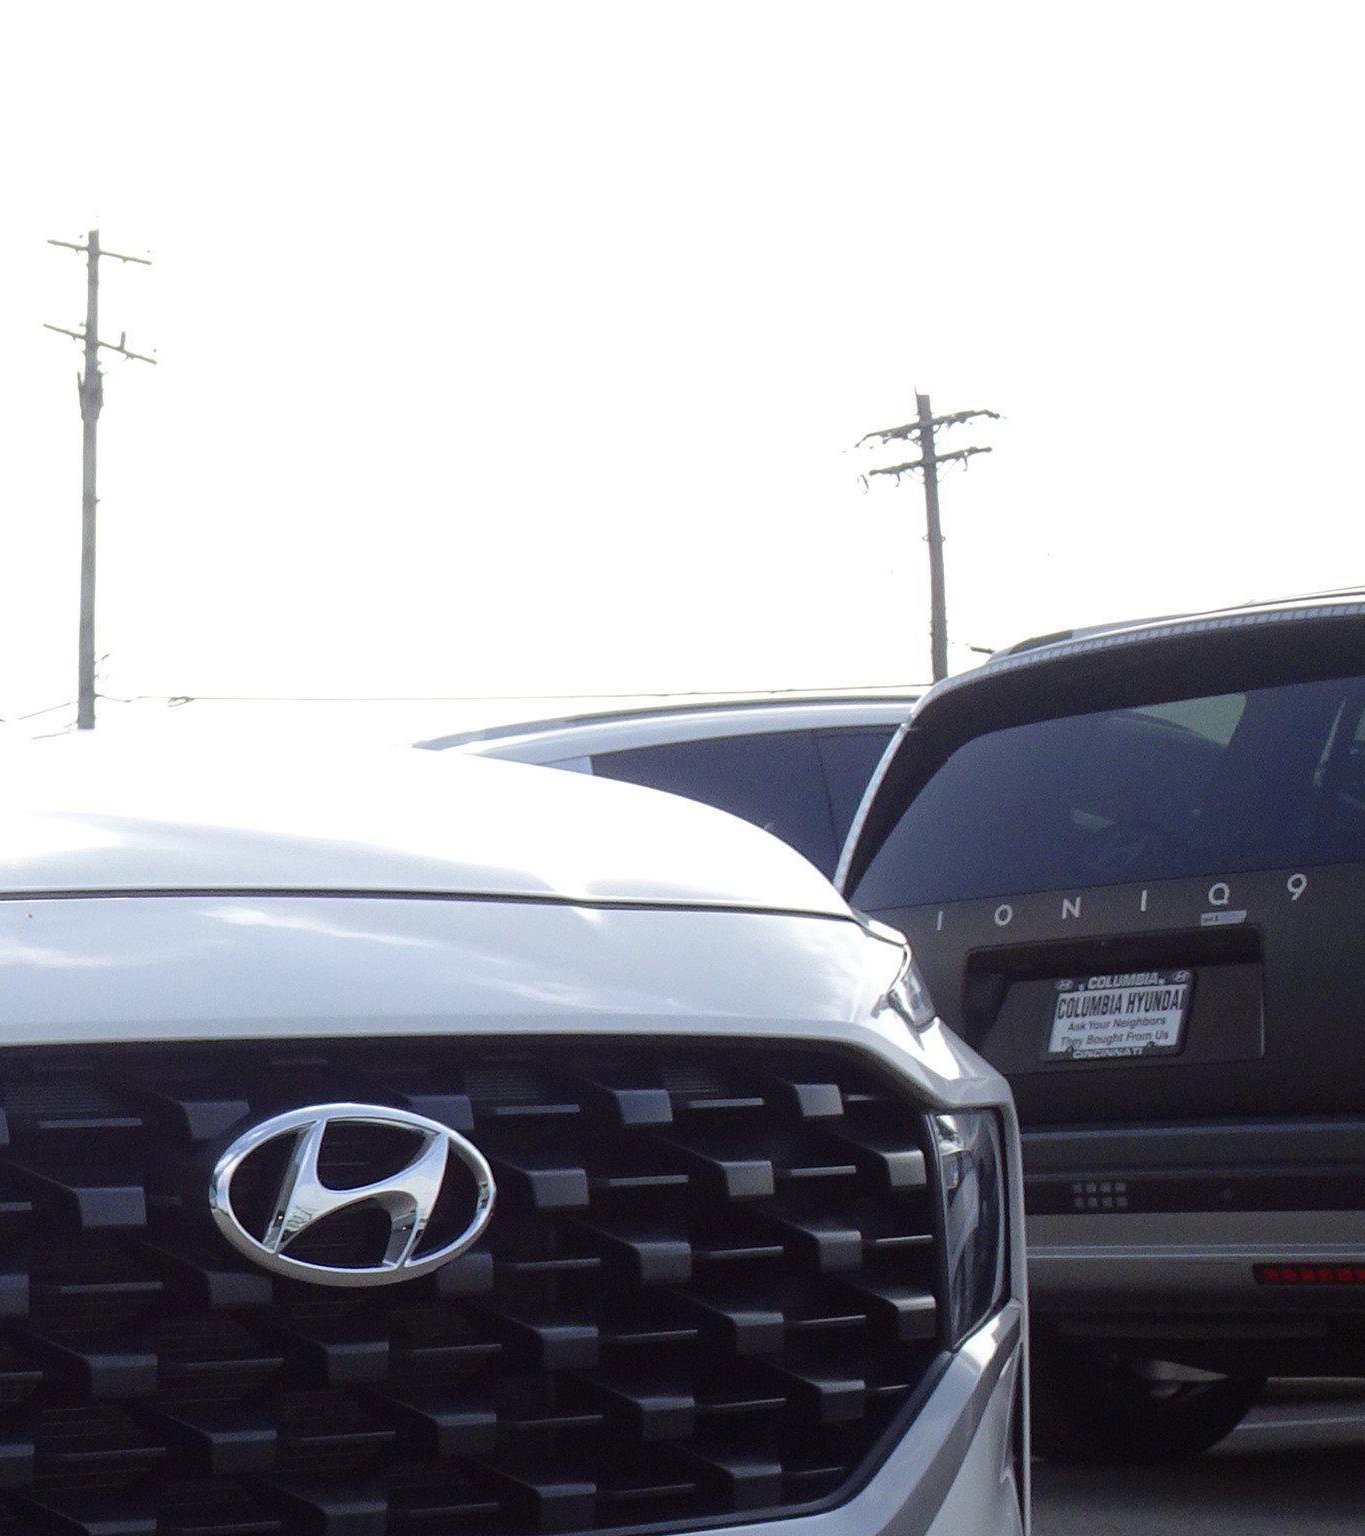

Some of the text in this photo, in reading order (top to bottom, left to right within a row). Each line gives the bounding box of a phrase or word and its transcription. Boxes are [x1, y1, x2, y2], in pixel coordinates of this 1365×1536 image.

[936, 882, 1230, 931] IONIQ
[1287, 873, 1308, 901] 9
[1087, 972, 1159, 989] COLUMBIA
[1058, 995, 1122, 1019] COLUMBIA
[1068, 1015, 1166, 1032] Ask Your Neighbors
[1061, 1030, 1169, 1048] They Bought From Us
